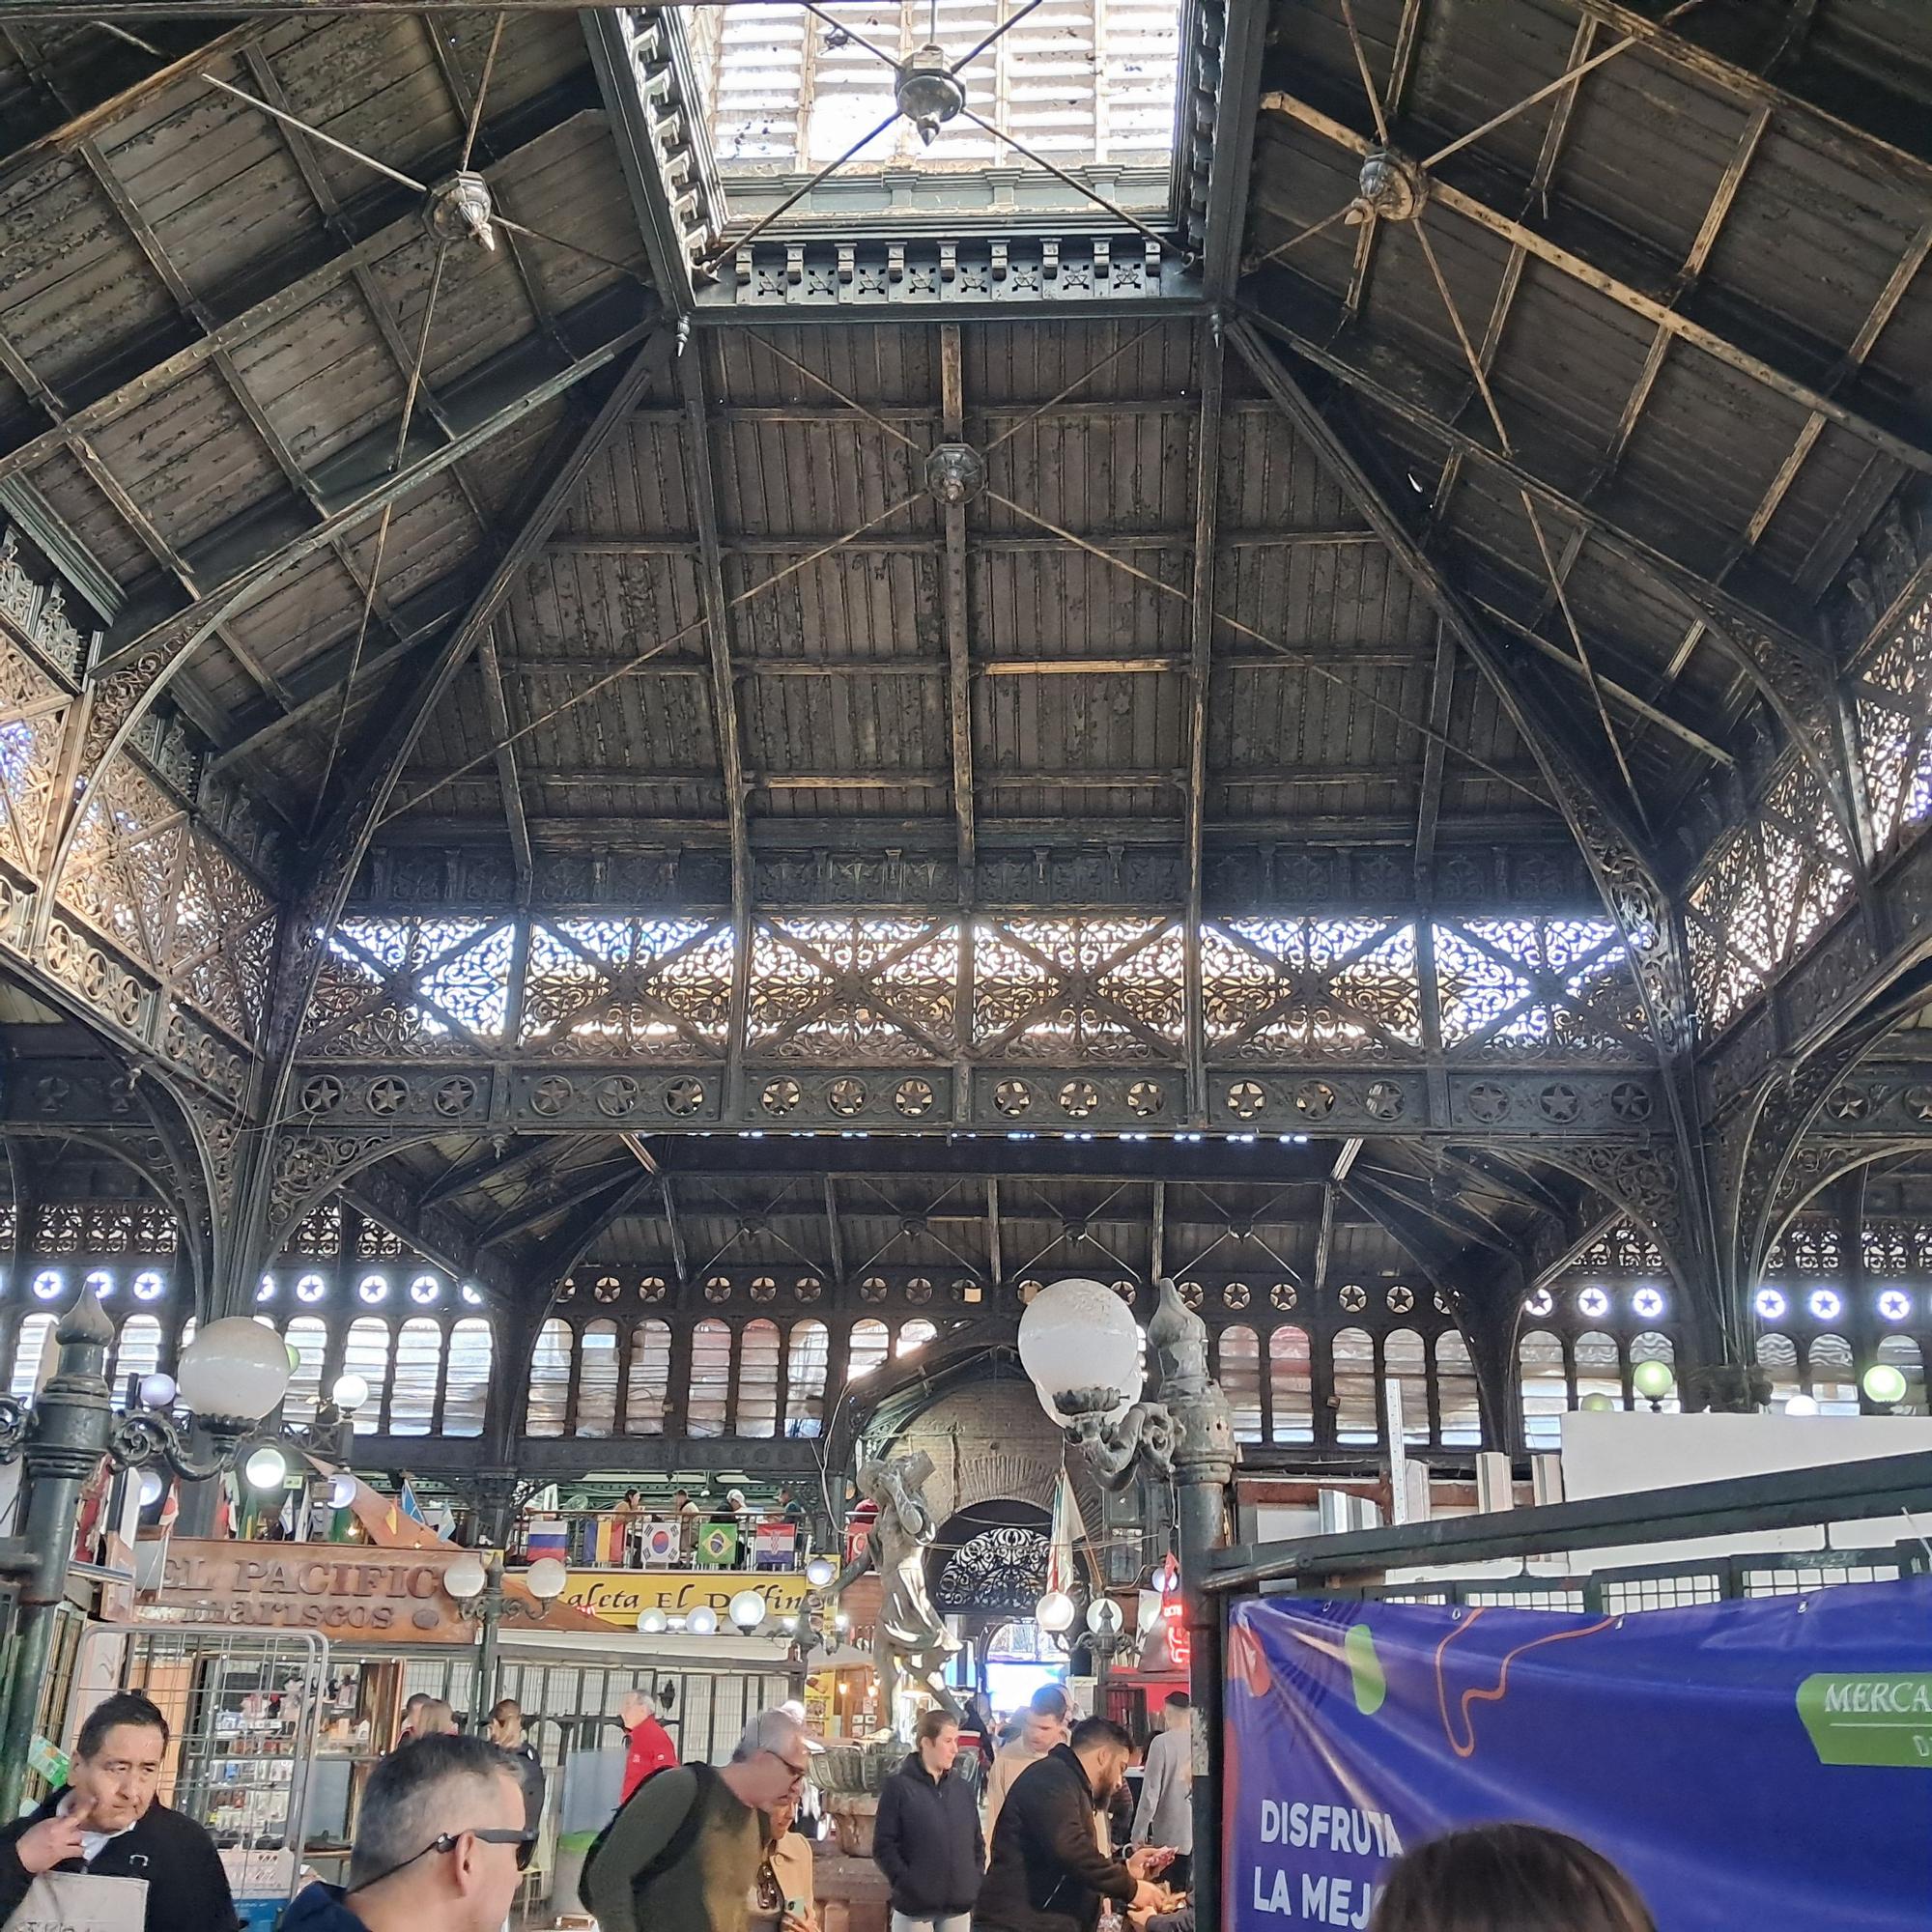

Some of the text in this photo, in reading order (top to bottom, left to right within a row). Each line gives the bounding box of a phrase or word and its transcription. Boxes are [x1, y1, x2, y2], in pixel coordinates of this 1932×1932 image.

[162, 1558, 440, 1599] EL PACIFIC
[557, 1582, 801, 1610] aleta El Dfin
[1824, 1682, 1932, 1713] MERCA
[1260, 1799, 1405, 1859] DISFRUTA
[1253, 1865, 1385, 1930] LA MEJ
